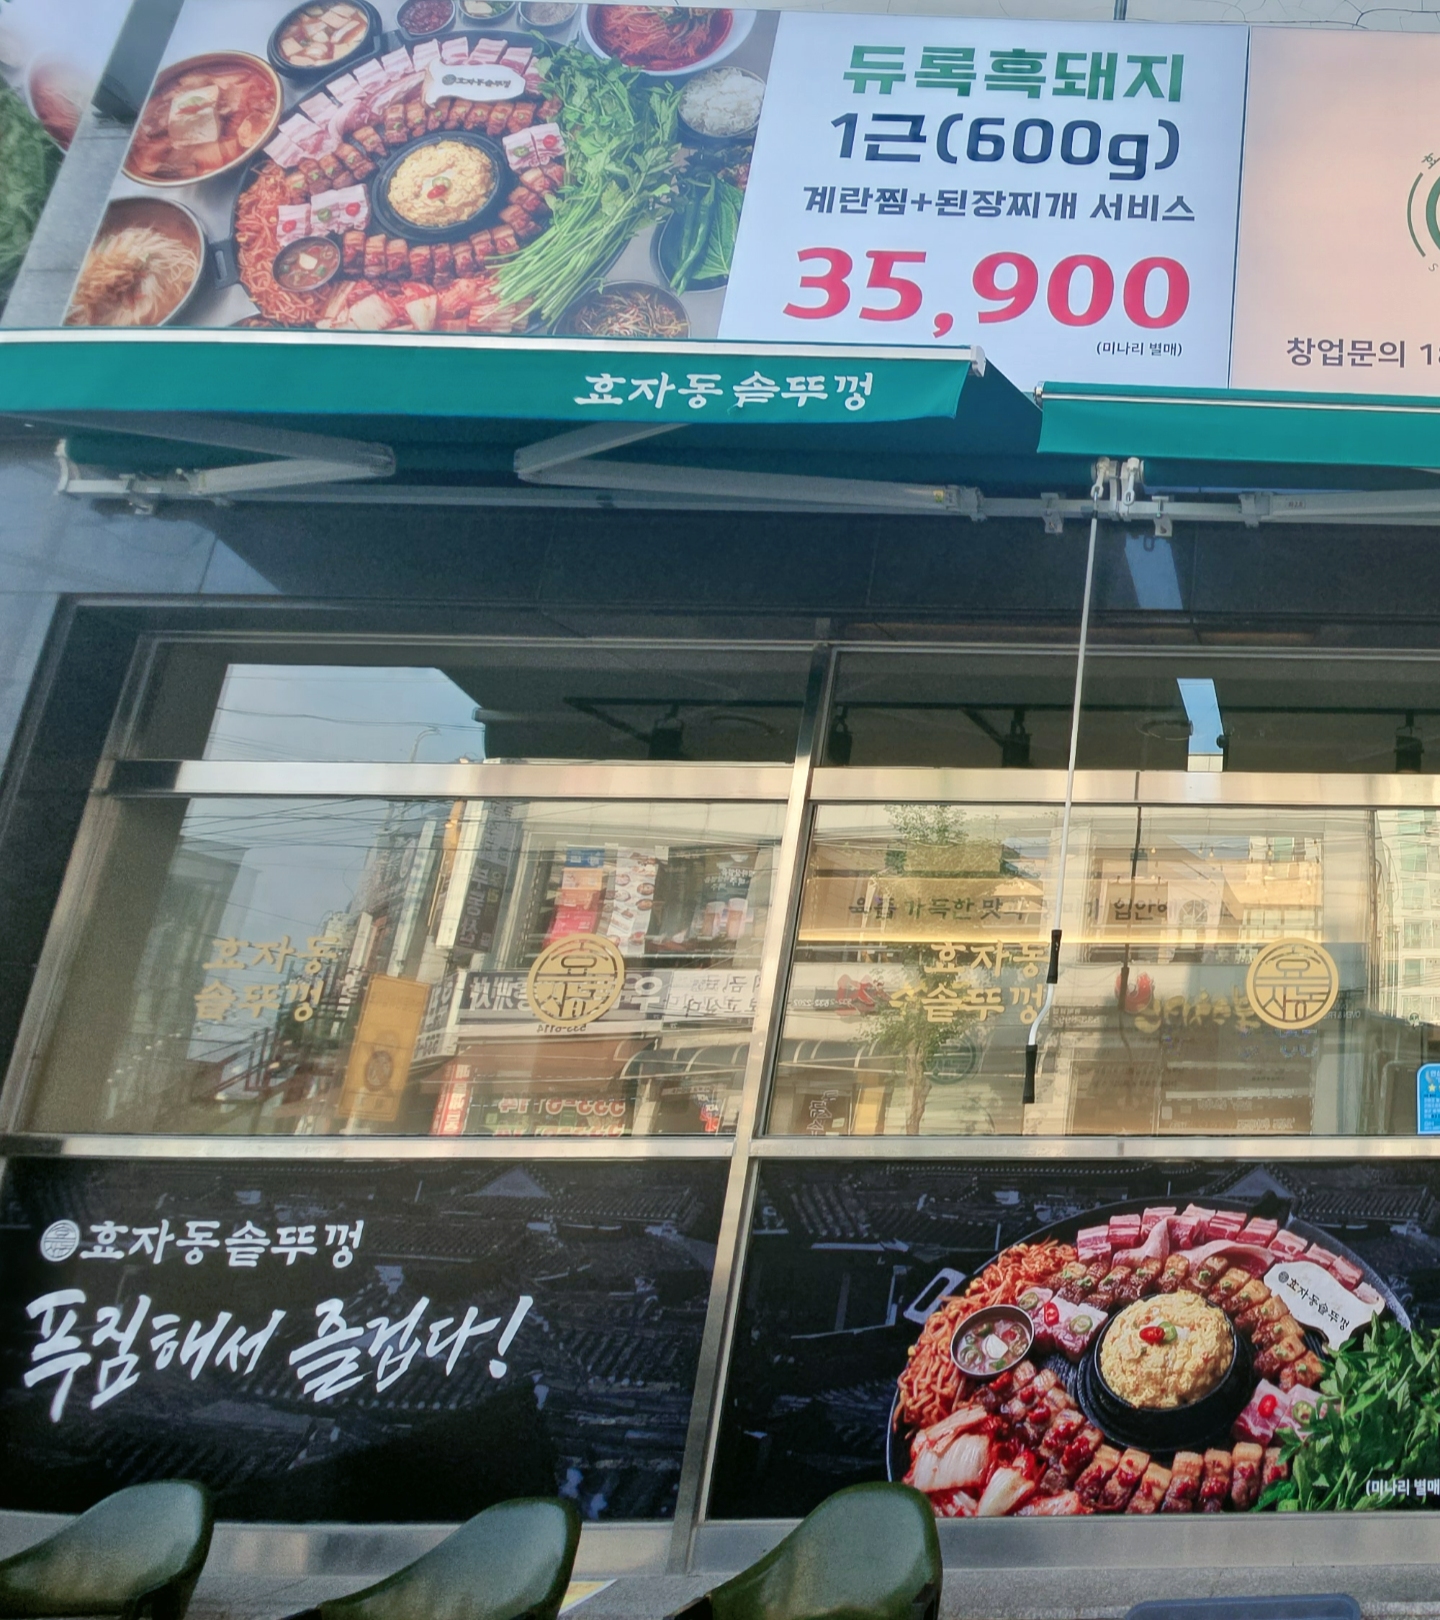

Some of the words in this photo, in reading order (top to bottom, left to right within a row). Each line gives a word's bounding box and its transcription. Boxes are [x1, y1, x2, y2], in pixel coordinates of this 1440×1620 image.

[842, 44, 1185, 103] 듀록흑돼지
[830, 112, 1181, 181] 1근(600g)
[803, 185, 1078, 220] 계란찜+된장찌개
[1089, 193, 1196, 223] 서비스
[782, 247, 1191, 338] 35,900
[1095, 341, 1144, 358] (미나리
[1148, 342, 1183, 358] 별매)
[1285, 337, 1406, 370] 창업문의
[575, 372, 874, 412] 효자동솥뚜껑
[904, 897, 976, 921] 가득한
[201, 934, 343, 976] 효자동
[923, 940, 1050, 980] 효자동
[193, 978, 324, 1023] 솥뚜껑
[921, 980, 1047, 1026] 솥뚜껑
[79, 1219, 366, 1269] 효자동솥뚜껑
[1286, 1275, 1351, 1333] 효자동솥뚜껑
[23, 1287, 287, 1423] 푸짐해서
[288, 1294, 535, 1403] 즐겁다!
[1363, 1477, 1412, 1498] (미나리
